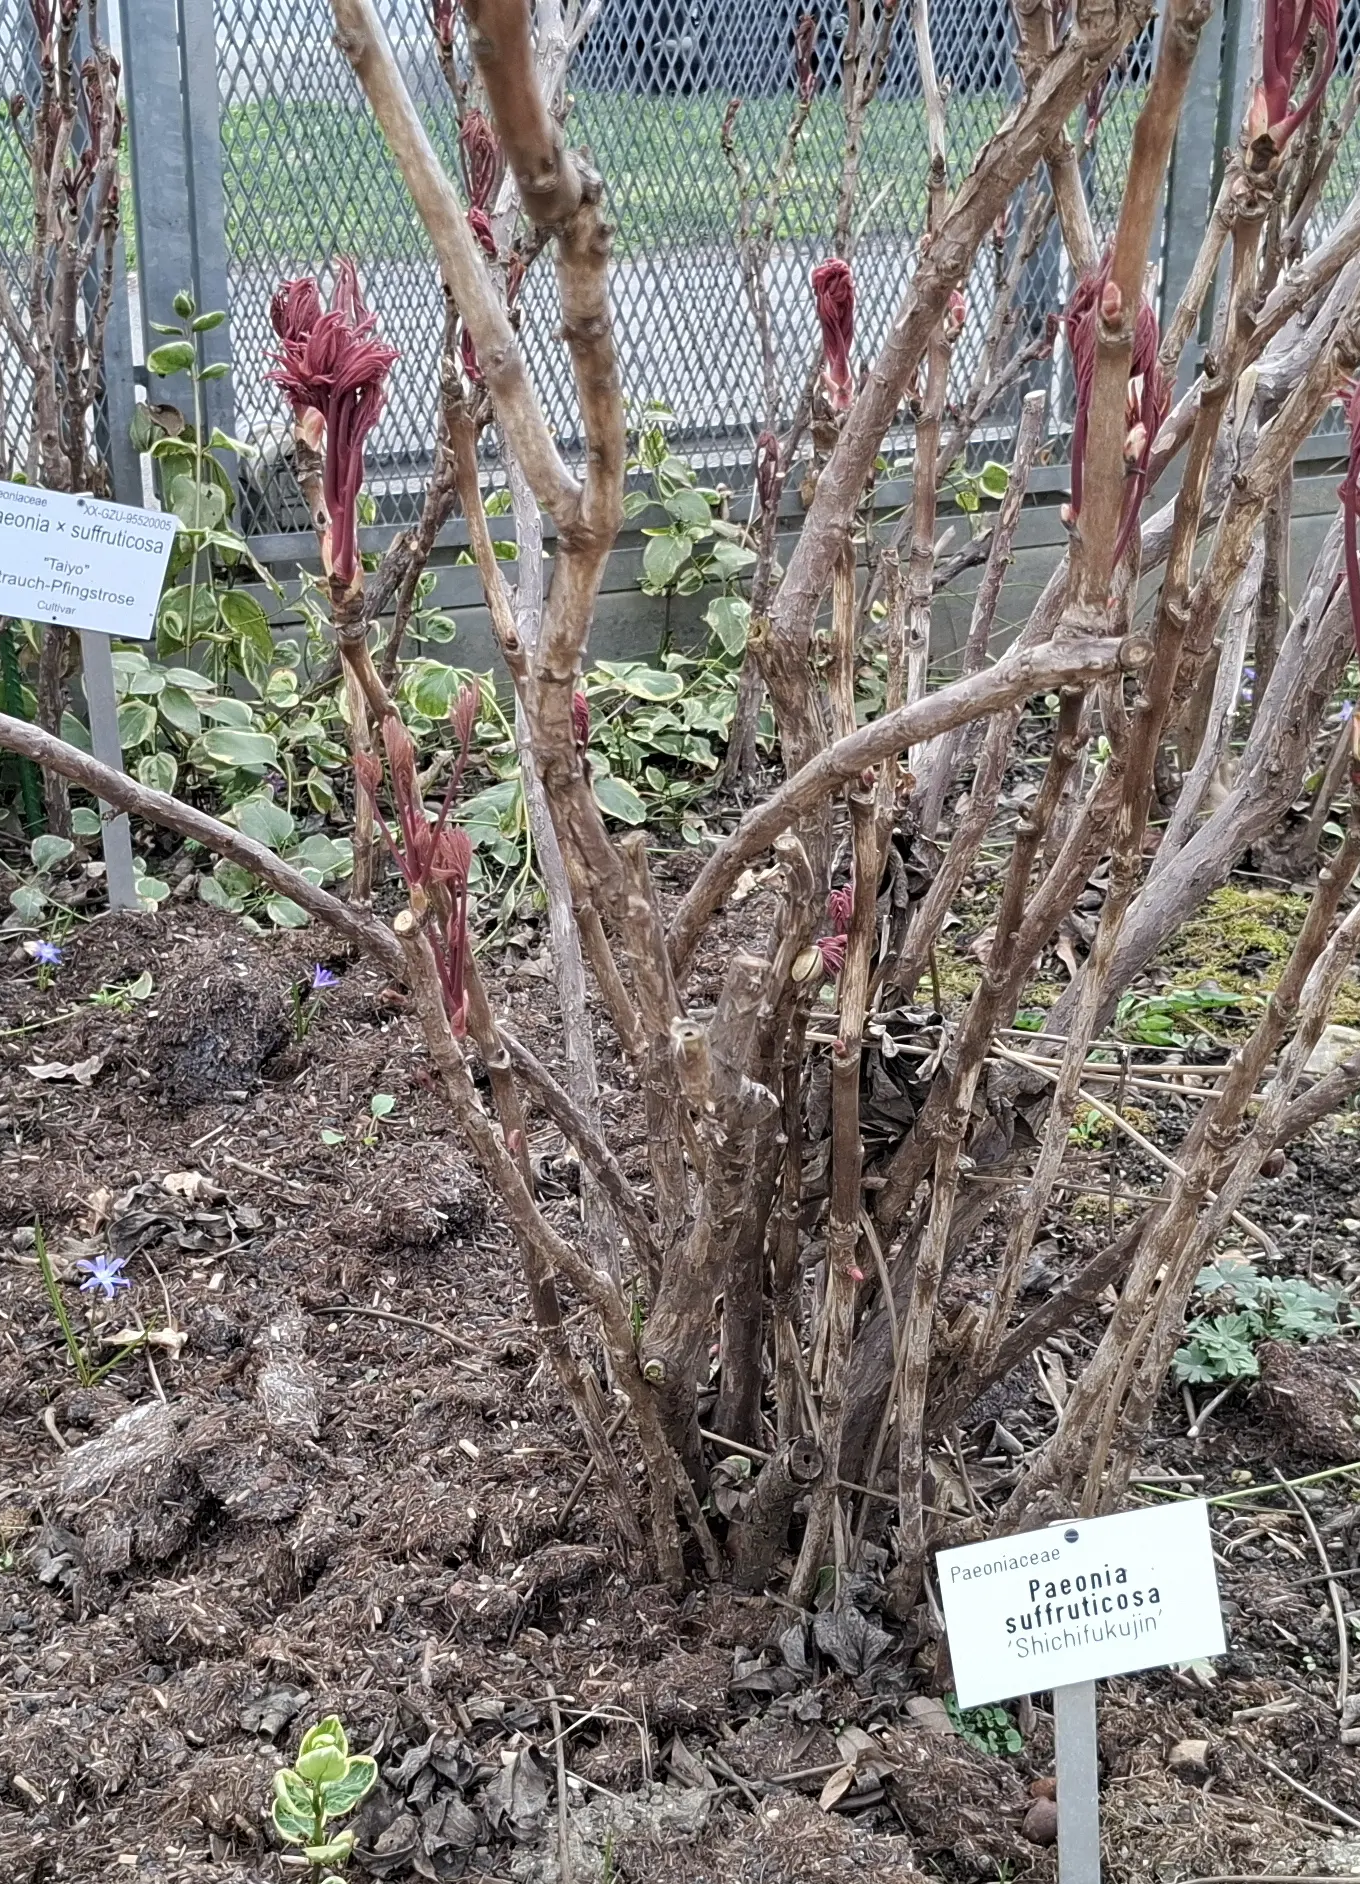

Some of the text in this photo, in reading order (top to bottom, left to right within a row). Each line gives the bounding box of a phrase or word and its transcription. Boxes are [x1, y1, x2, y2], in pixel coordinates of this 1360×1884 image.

[83, 503, 172, 531] XX-GZU-95520005
[70, 524, 164, 554] suffruticosa
[37, 600, 76, 615] Cultivar
[950, 1547, 1061, 1583] Paeoniaceae
[1028, 1564, 1128, 1602] Paeonia
[1005, 1586, 1161, 1634] suffruticosa
